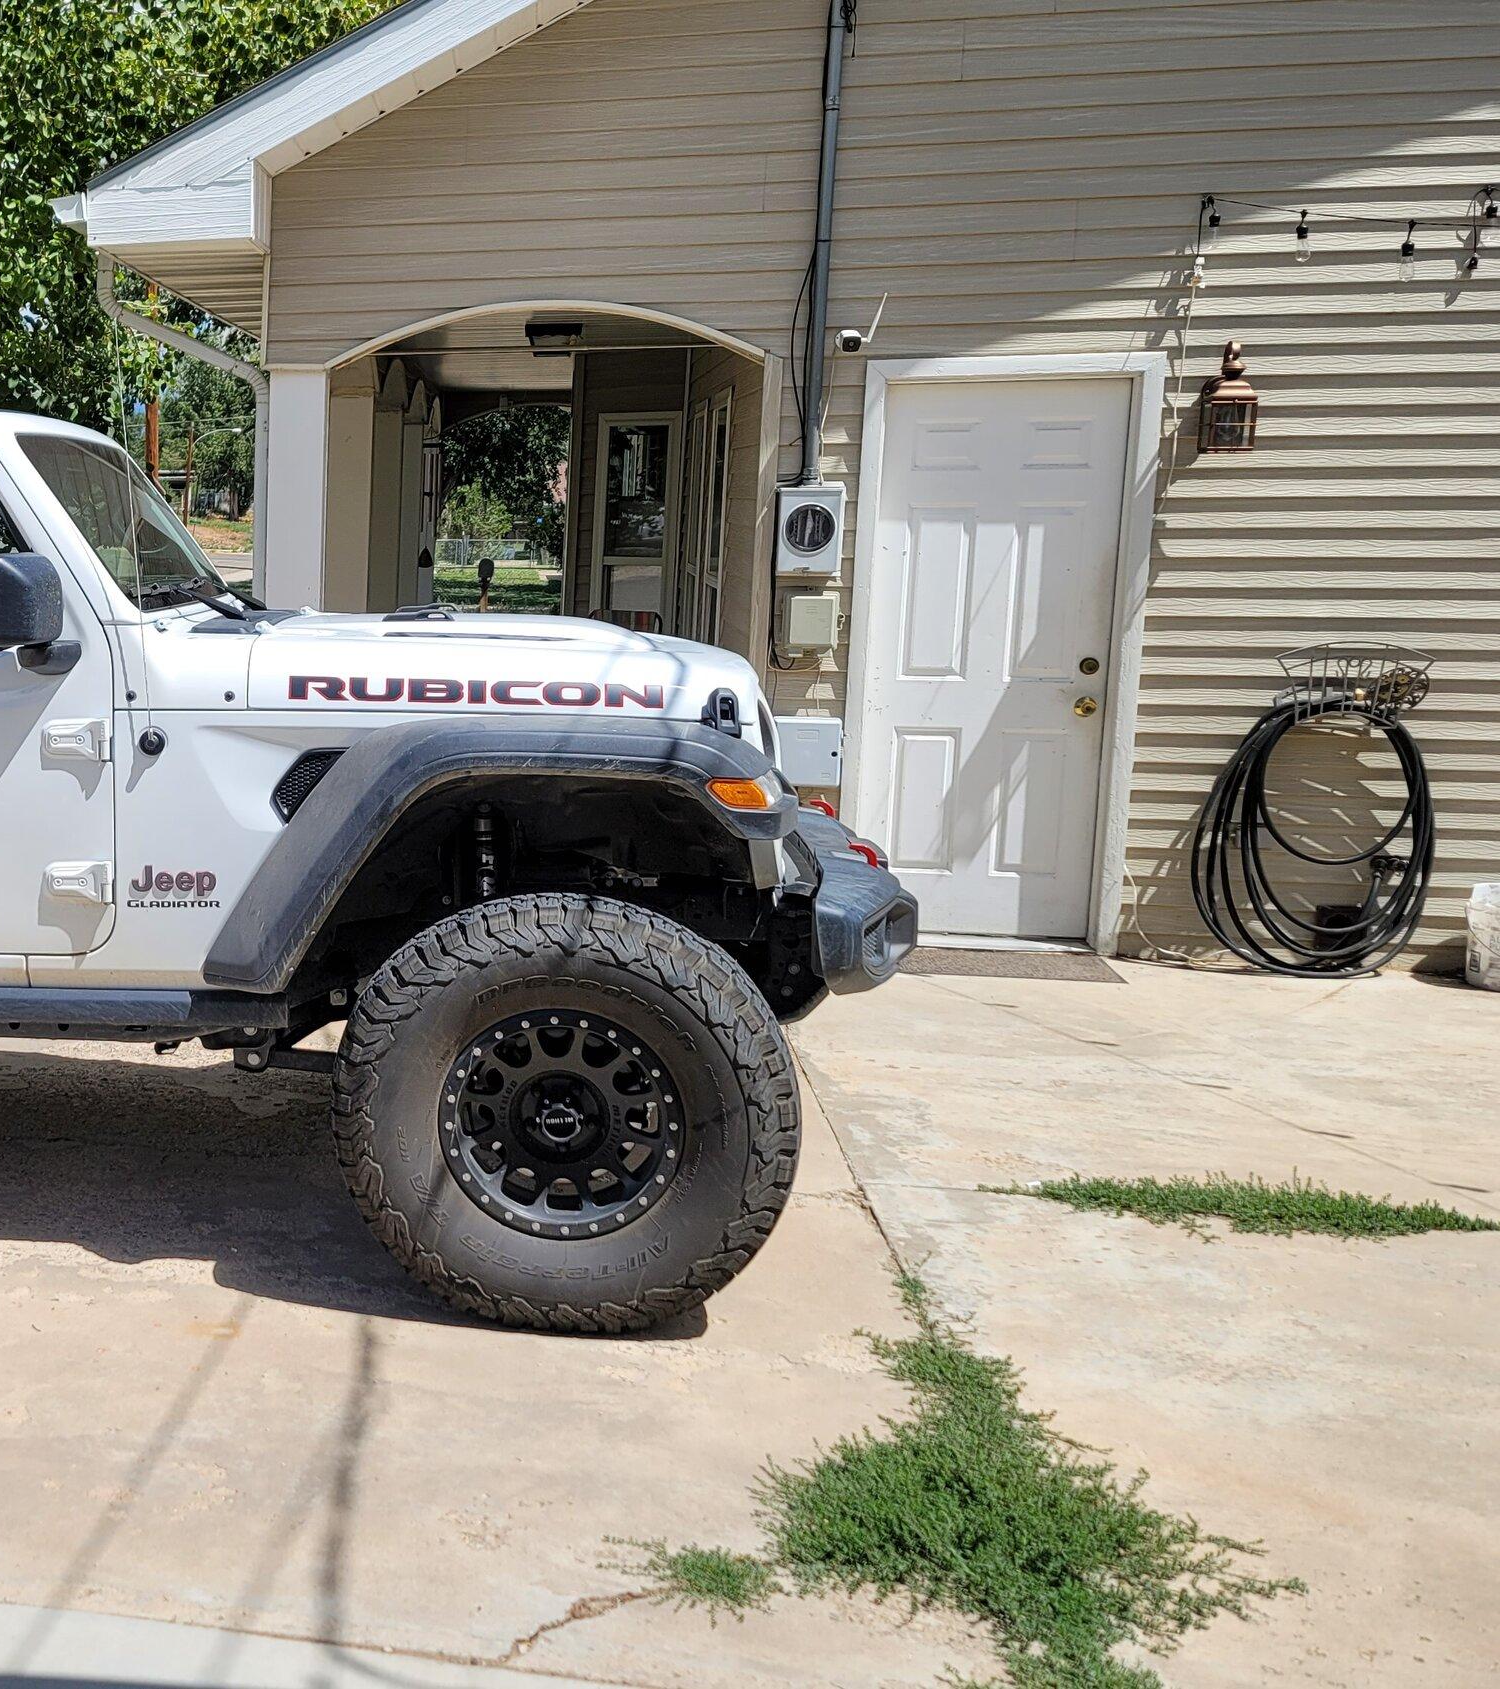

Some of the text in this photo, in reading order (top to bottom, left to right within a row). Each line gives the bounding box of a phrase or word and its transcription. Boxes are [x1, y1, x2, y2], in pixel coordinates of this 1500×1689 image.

[288, 676, 664, 709] RUBICON
[131, 865, 217, 897] Jeep
[127, 899, 221, 908] GLADIATOR
[475, 974, 697, 1051] BFGoodrich
[459, 1232, 671, 1281] All-Terrain
